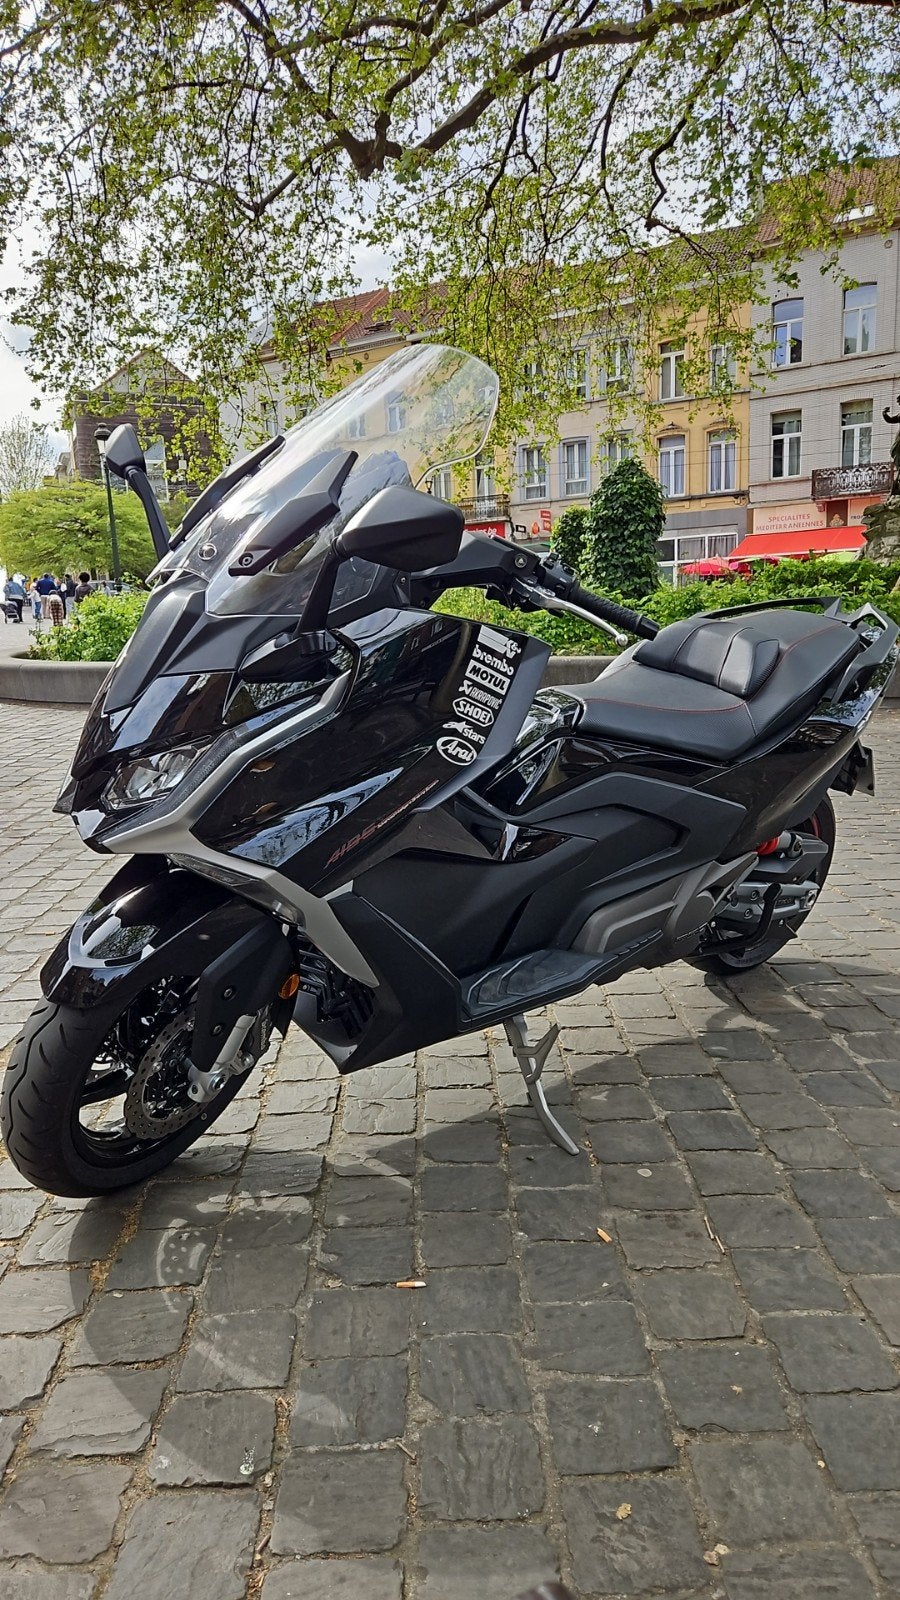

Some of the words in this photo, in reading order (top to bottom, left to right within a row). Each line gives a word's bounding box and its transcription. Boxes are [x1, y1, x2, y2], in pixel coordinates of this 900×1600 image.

[472, 644, 514, 676] brembo
[469, 664, 507, 692] MOTUL
[458, 700, 491, 724] SHOEI
[441, 740, 474, 762] Arai
